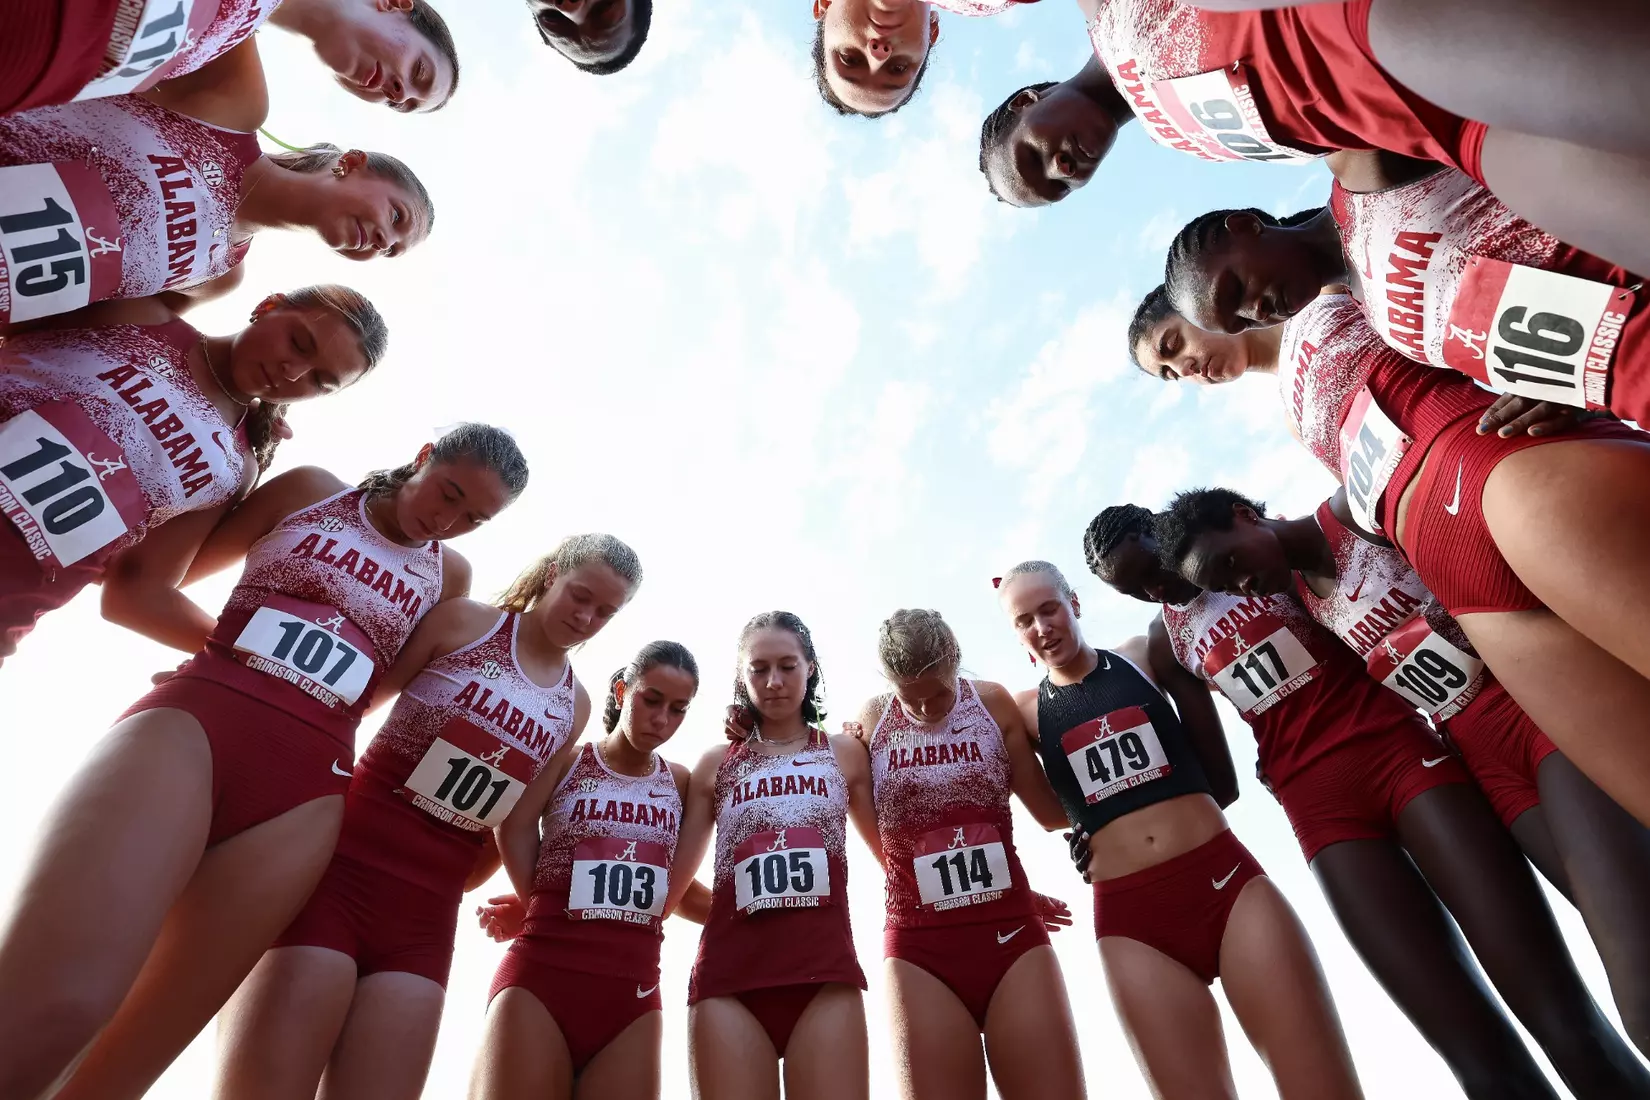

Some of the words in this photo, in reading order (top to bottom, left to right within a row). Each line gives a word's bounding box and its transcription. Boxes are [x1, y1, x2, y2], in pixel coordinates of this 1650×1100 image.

[1189, 98, 1296, 162] 106
[202, 159, 224, 189] SEC
[0, 197, 85, 297] 115
[1493, 306, 1585, 389] 116
[1586, 311, 1626, 371] CLASSIC
[149, 355, 176, 380] SEC
[96, 363, 214, 499] ALABAMA
[0, 437, 105, 535] 110
[1348, 422, 1387, 514] 104
[12, 511, 52, 561] CLASSIC
[318, 516, 345, 533] SEC
[291, 533, 423, 625] ALABAMA
[272, 621, 359, 687] 107
[480, 660, 501, 680] SEC
[1231, 641, 1290, 698] 117
[1395, 648, 1468, 707] 109
[245, 655, 301, 684] CRIMSON
[299, 678, 340, 710] CLASSIC
[1280, 672, 1313, 697] CLASSIC
[888, 742, 984, 772] ALABAMA
[1085, 731, 1151, 785] 479
[412, 794, 456, 823] CRIMSON
[434, 756, 510, 821] 101
[731, 775, 829, 809] ALABAMA
[1095, 779, 1129, 802] CRIMSON
[1129, 768, 1163, 787] CLASSIC
[569, 799, 676, 836] ALABAMA
[588, 863, 656, 910] 103
[745, 851, 815, 898] 105
[932, 848, 993, 896] 114
[784, 896, 819, 908] CLASSIC
[971, 890, 1003, 904] CLASSIC
